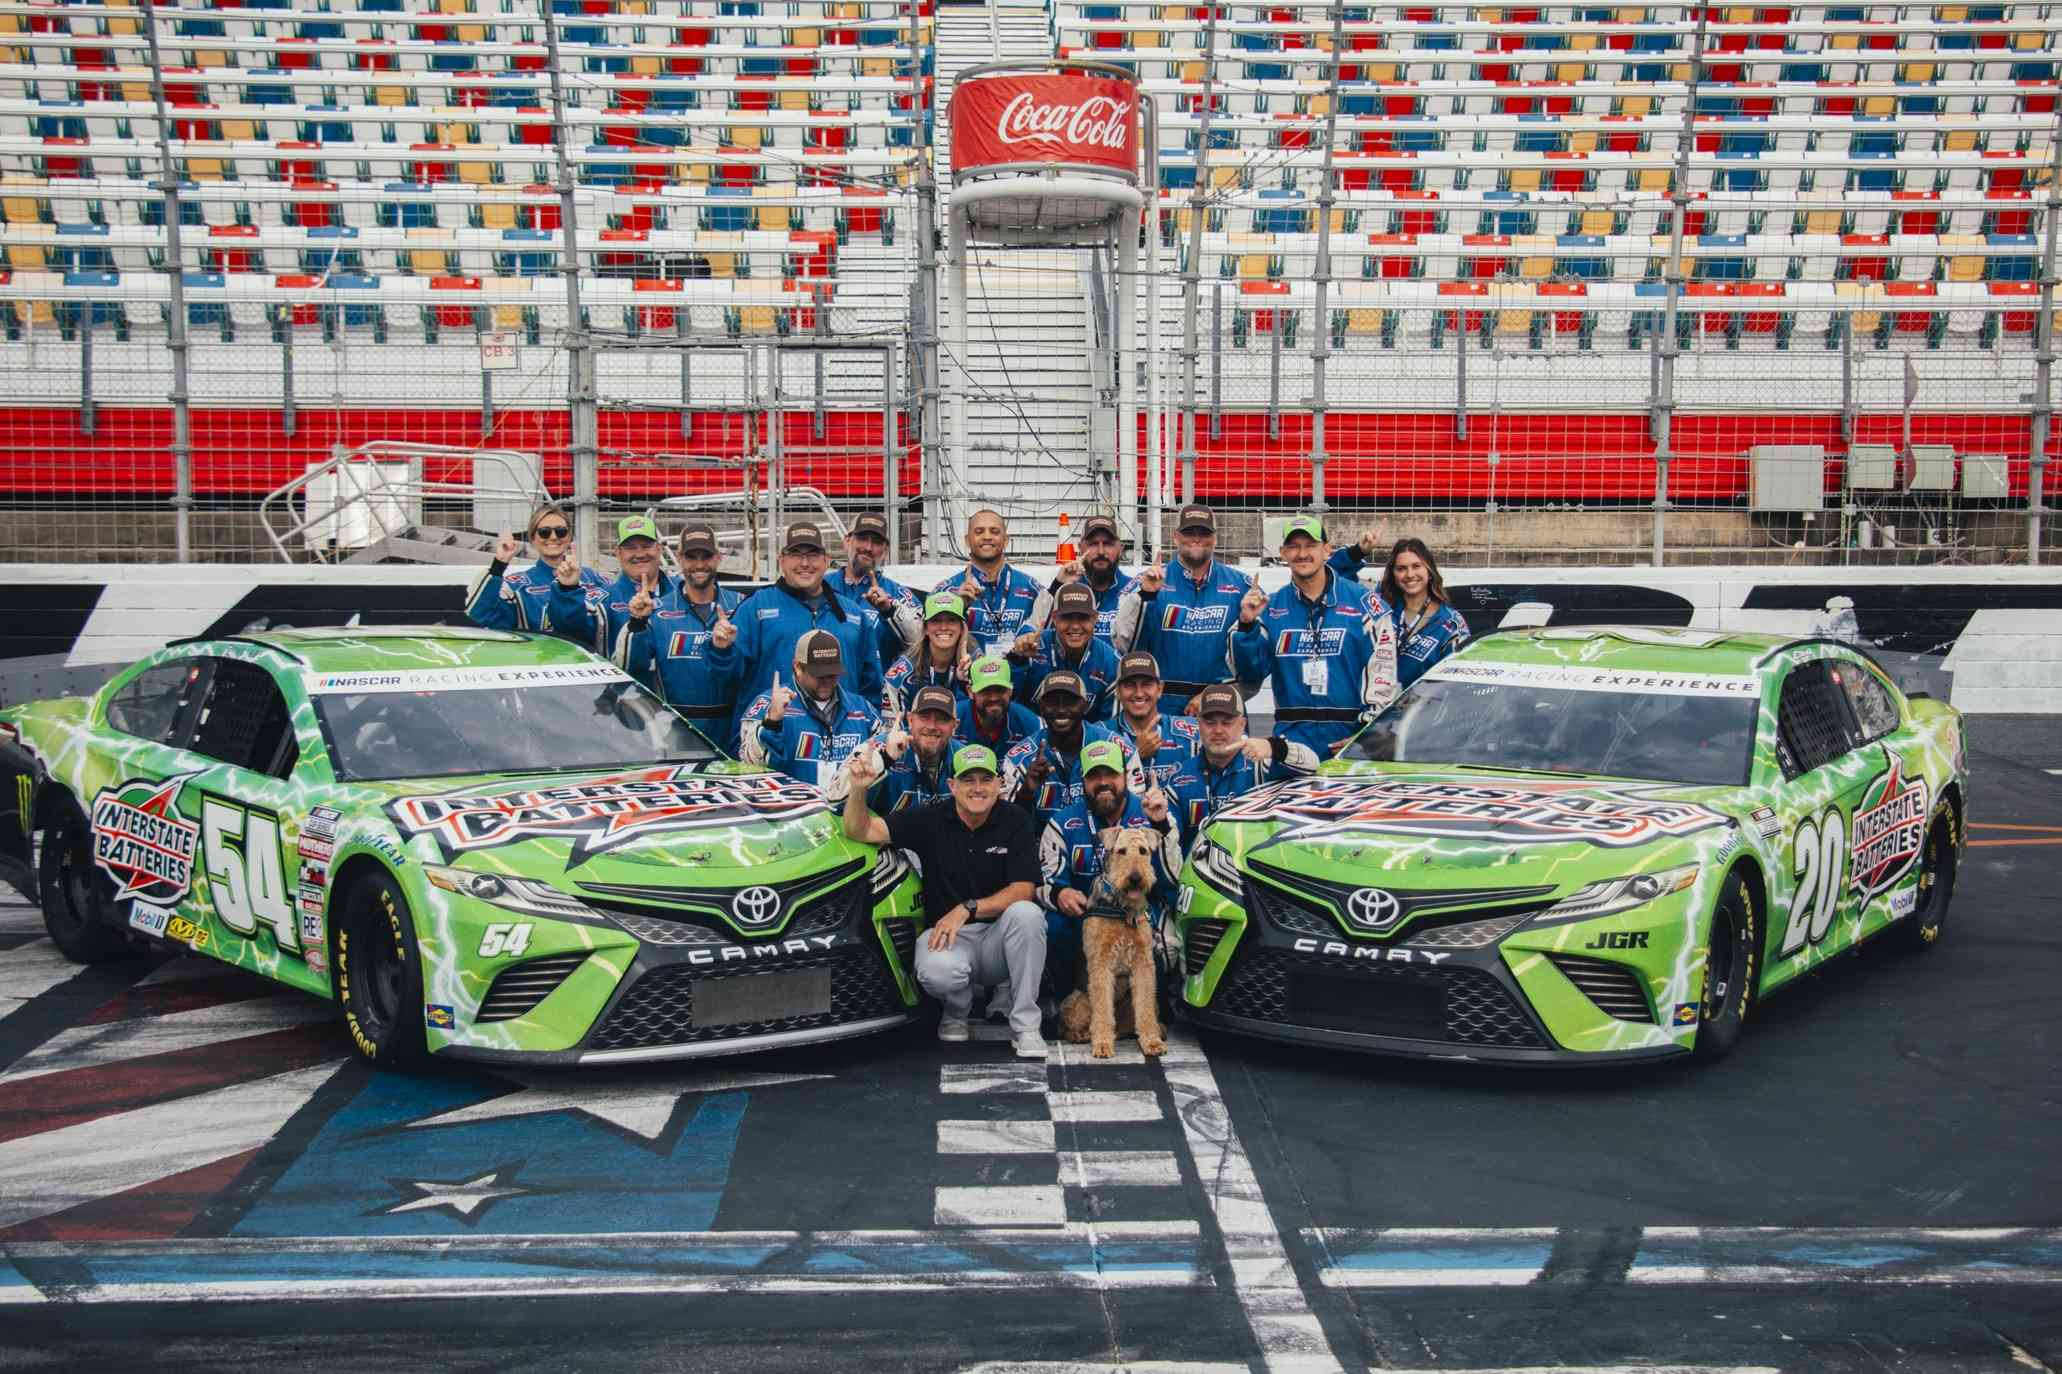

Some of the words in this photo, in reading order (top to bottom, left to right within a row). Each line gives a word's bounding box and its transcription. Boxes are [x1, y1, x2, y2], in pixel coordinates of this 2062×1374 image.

[998, 92, 1132, 148] Coca-Cola
[1186, 608, 1224, 620] NASCAR
[1299, 631, 1341, 643] NACAR
[335, 676, 401, 687] NASCAR
[409, 673, 493, 685] RACING
[498, 667, 623, 682] EXPERIENCE
[1506, 671, 1586, 683] RACING
[1592, 674, 1754, 692] EXPERIENCE
[420, 776, 801, 822] INTERSTATE
[460, 787, 818, 839] BATTERIES
[1855, 791, 1924, 847] INTERSTATE
[97, 803, 193, 856] INTERSTATE
[1855, 823, 1921, 877] BATTERIES
[99, 836, 186, 884] BATTERIES
[203, 798, 301, 951] 54
[1782, 809, 1845, 953] 20
[381, 889, 405, 961] EAGLE
[477, 923, 531, 957] 54
[1585, 931, 1649, 949] JGR
[687, 934, 836, 965] CAMRY
[1293, 938, 1452, 965] CAMRY
